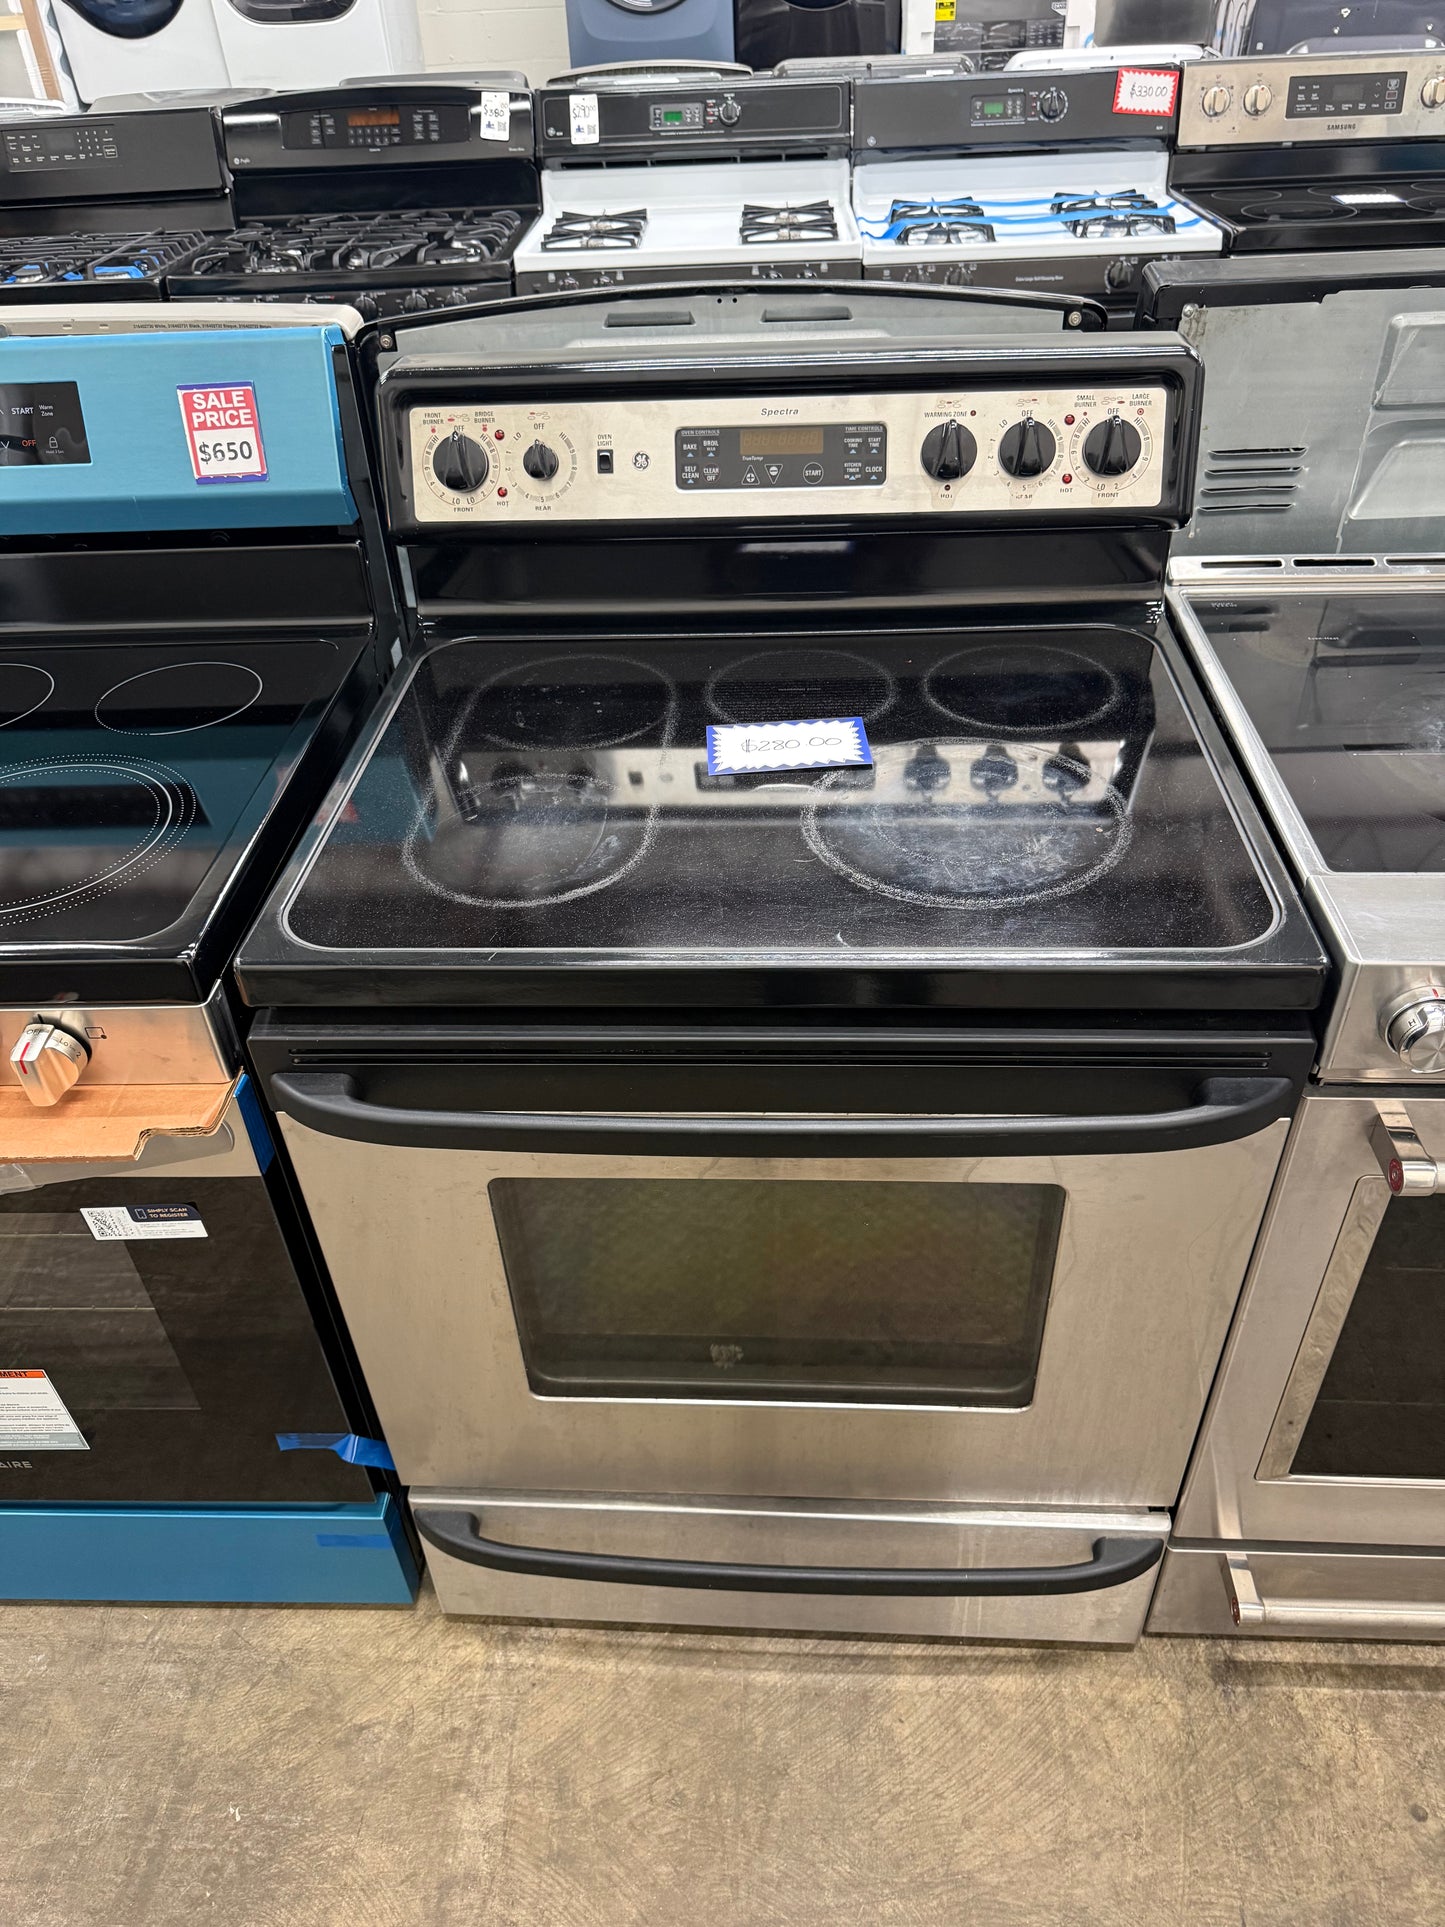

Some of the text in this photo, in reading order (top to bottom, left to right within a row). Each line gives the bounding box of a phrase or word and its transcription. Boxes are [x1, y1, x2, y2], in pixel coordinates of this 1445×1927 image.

[1326, 123, 1356, 131] SAMSUNG
[192, 390, 246, 410] SALE
[11, 407, 34, 415] START
[760, 407, 799, 416] Spectra
[192, 409, 253, 428] PRICE
[1047, 418, 1056, 428] HI
[1082, 418, 1091, 427] HI
[1133, 416, 1142, 426] HI
[998, 419, 1008, 429] LO
[431, 434, 440, 444] HI
[479, 433, 488, 442] HI
[513, 432, 522, 441] LO
[558, 431, 567, 441] HI
[21, 439, 36, 447] OFF
[199, 441, 252, 465] $650
[1096, 483, 1106, 491] LO
[466, 496, 476, 505] LO
[741, 736, 842, 753] $280.00
